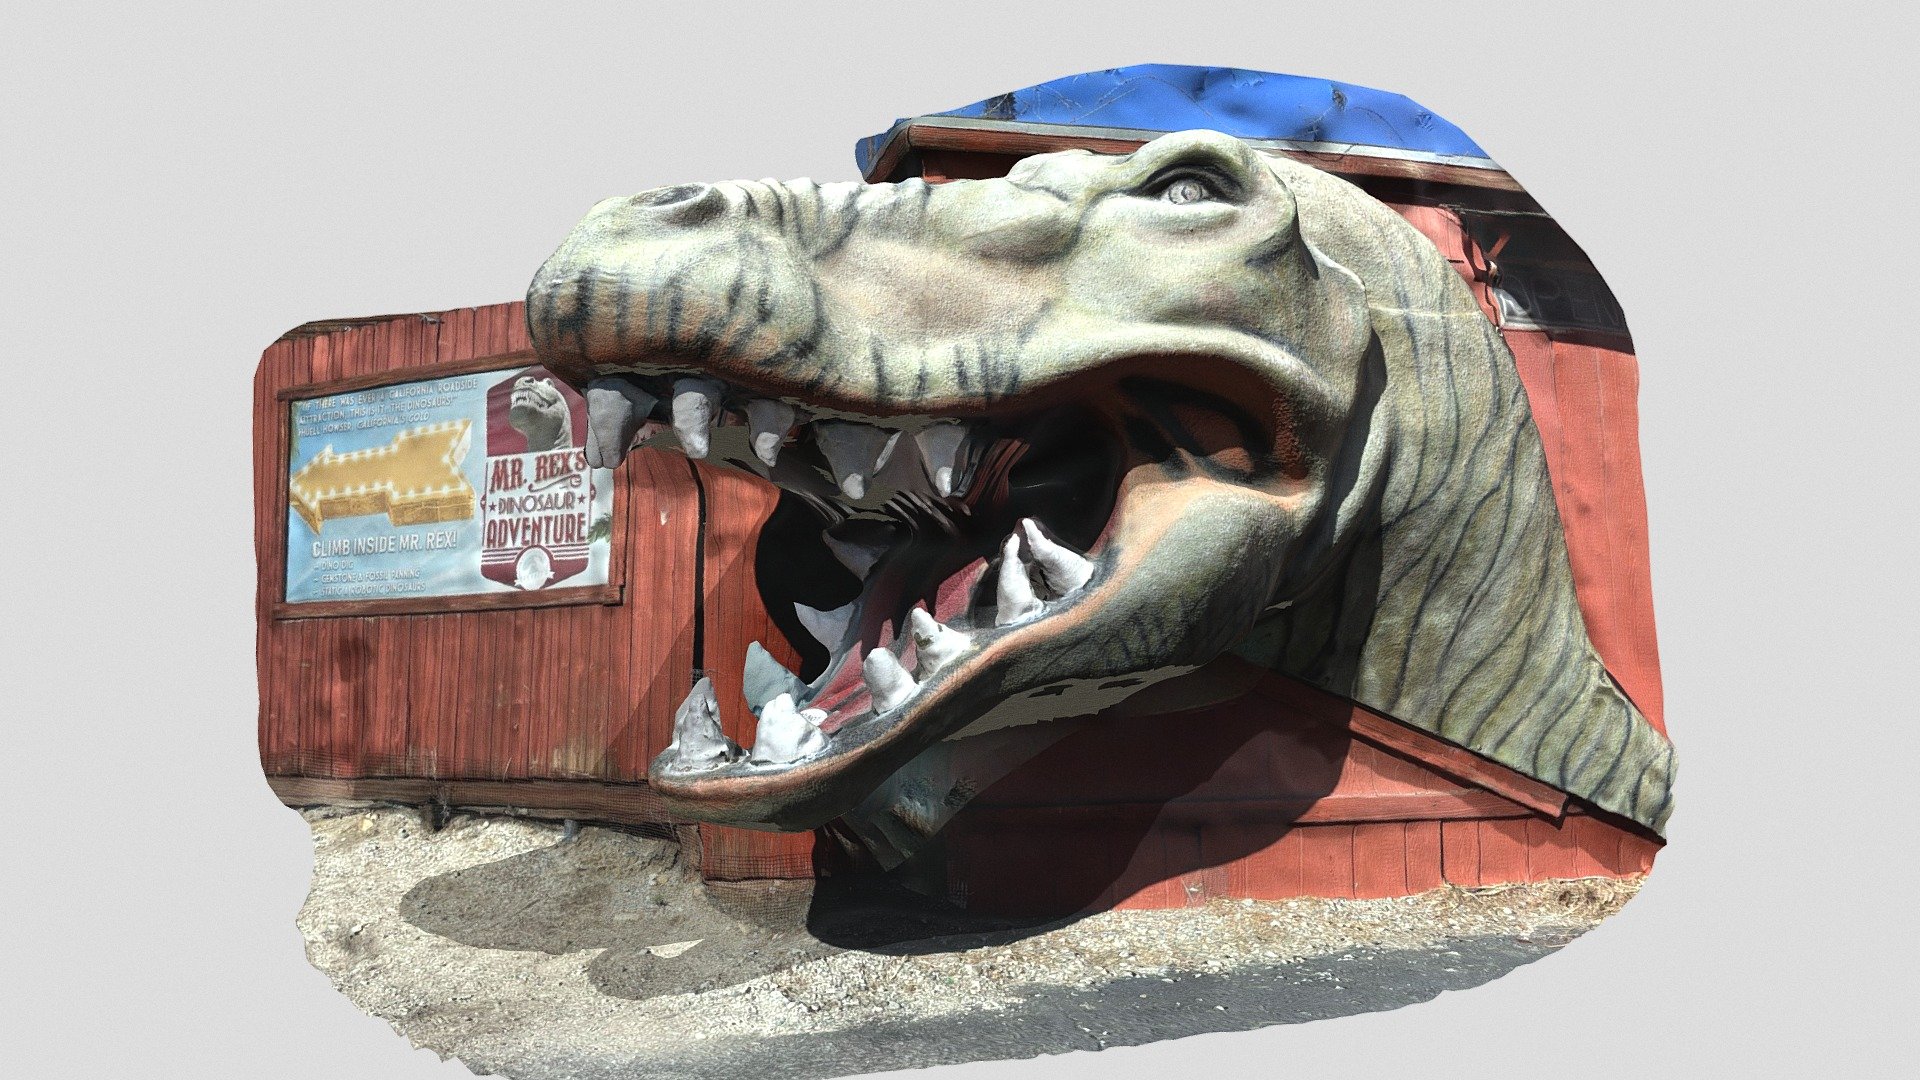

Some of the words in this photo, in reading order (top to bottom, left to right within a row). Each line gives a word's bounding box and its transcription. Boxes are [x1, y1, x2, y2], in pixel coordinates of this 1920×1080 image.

[340, 395, 355, 407] WAS
[389, 386, 433, 400] CALIFORNIA
[438, 378, 479, 393] ROADSIDE
[408, 411, 430, 423] GOLD
[489, 457, 528, 494] MR.
[534, 450, 588, 484] REX'S
[498, 491, 576, 515] DINOSAUR
[486, 512, 587, 548] ADVENTURE
[312, 538, 350, 558] CLIMB
[352, 535, 397, 556] INSIDE
[399, 533, 422, 552] MR.
[426, 530, 457, 551] REX!
[392, 568, 420, 580] PANNING
[385, 581, 426, 595] DINOSAURS
